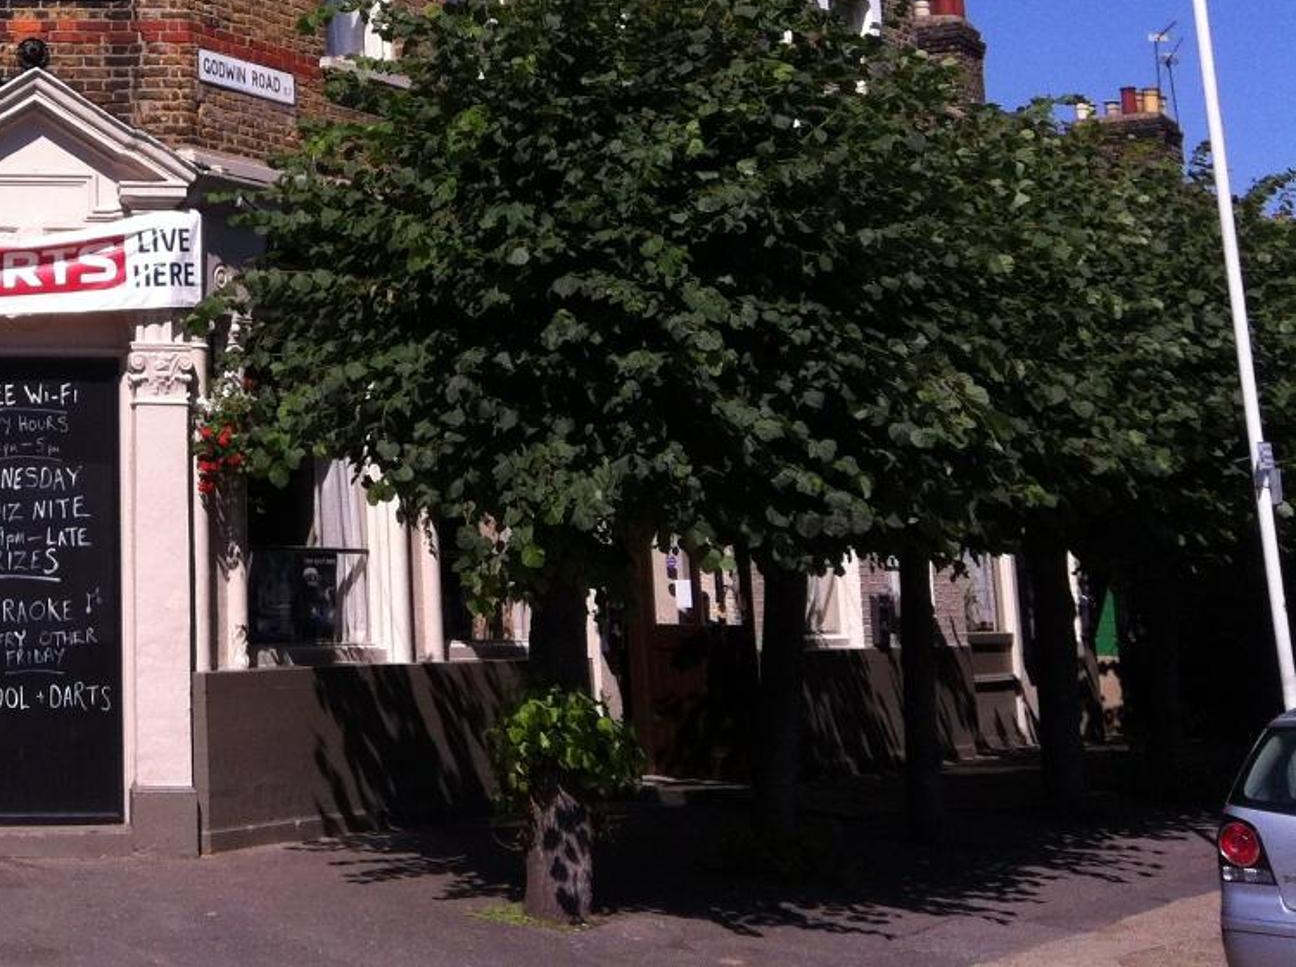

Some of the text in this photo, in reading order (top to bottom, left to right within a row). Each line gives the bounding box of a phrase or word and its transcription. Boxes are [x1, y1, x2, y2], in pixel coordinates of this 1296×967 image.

[204, 57, 247, 85] GODWIN
[251, 70, 281, 94] ROAD
[137, 227, 192, 254] LIVE
[134, 262, 196, 289] HERE
[18, 416, 69, 433] HOURS
[32, 495, 92, 521] NITE
[39, 627, 98, 647] OTHER
[6, 648, 65, 667] FRIDAY
[49, 681, 111, 712] DARTS
